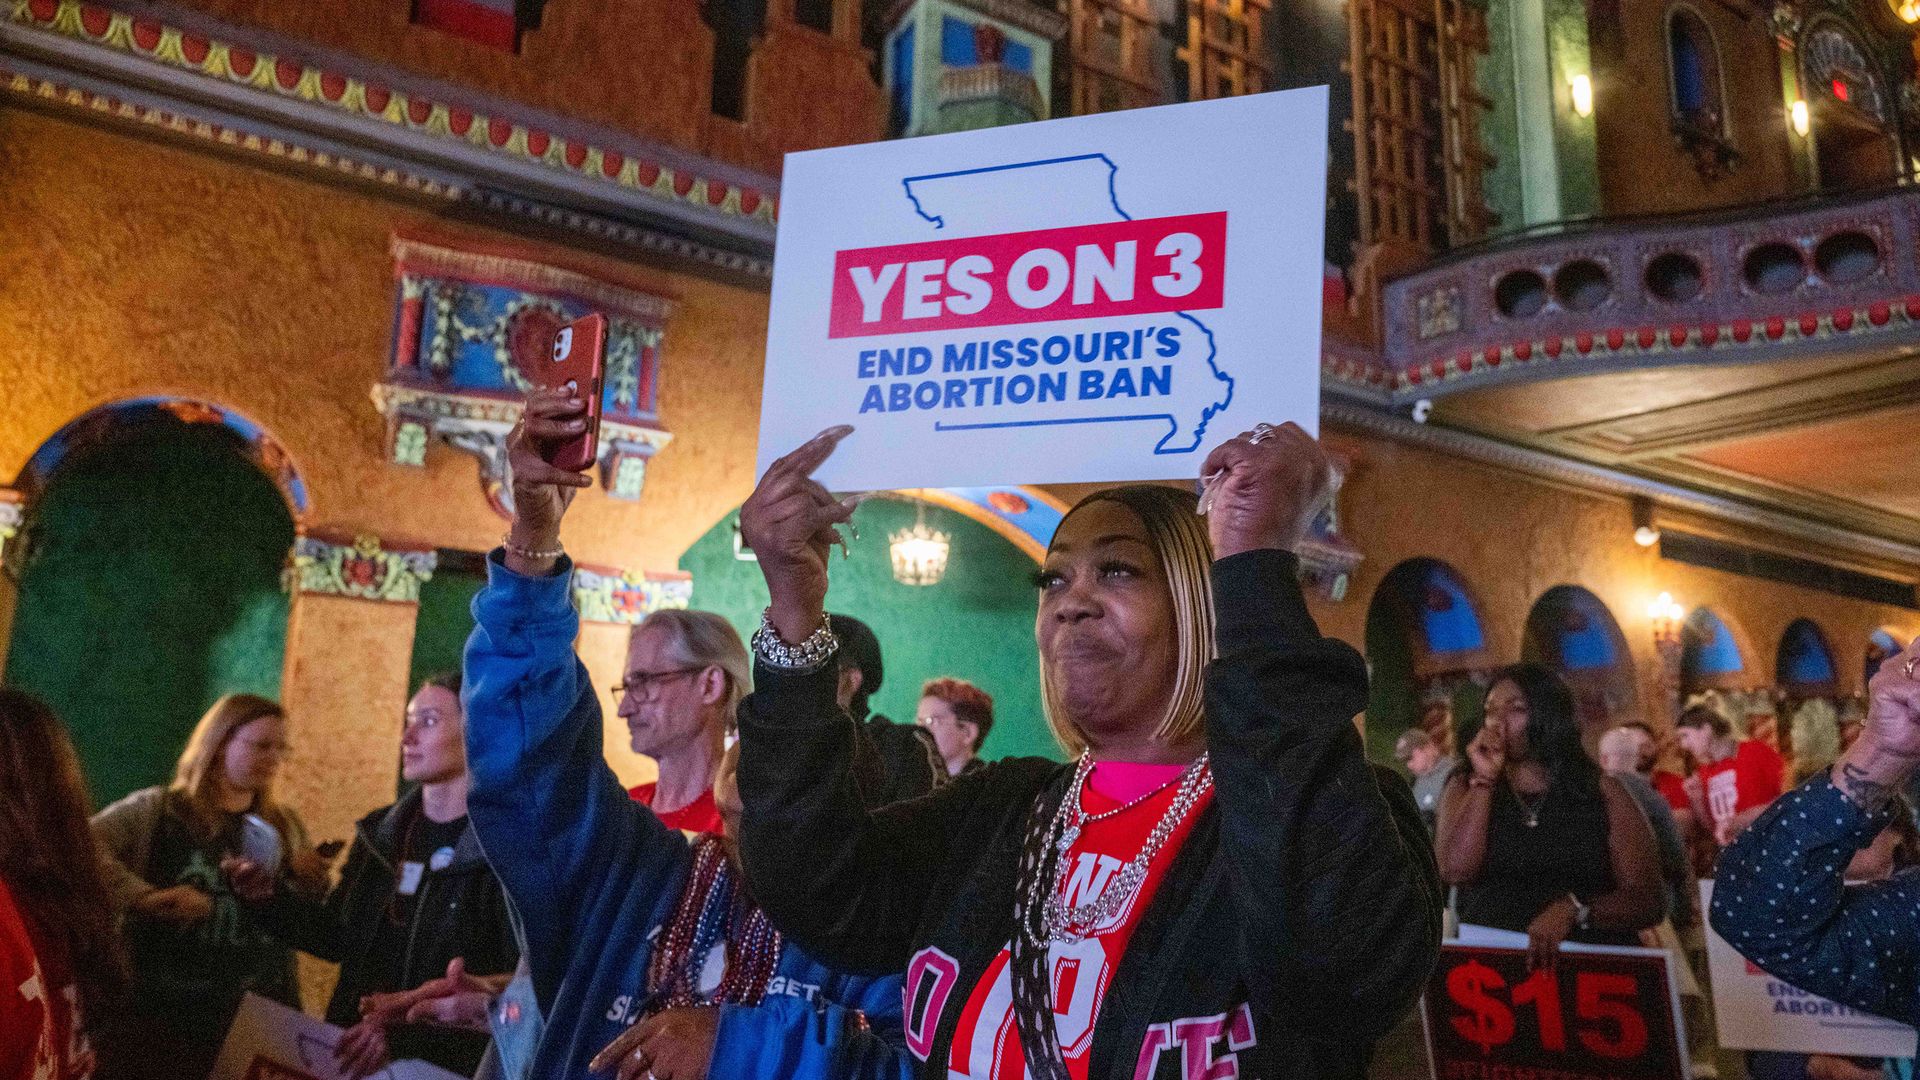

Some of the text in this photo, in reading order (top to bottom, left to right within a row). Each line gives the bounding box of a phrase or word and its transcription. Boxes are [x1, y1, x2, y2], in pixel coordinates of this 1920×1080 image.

[849, 232, 1204, 324] YES ON 3
[858, 326, 1181, 379] END MISSOURI’S
[858, 365, 1172, 414] ABORTION BAN
[1446, 959, 1649, 1060] $15
[1774, 1000, 1858, 1017] ABORT
